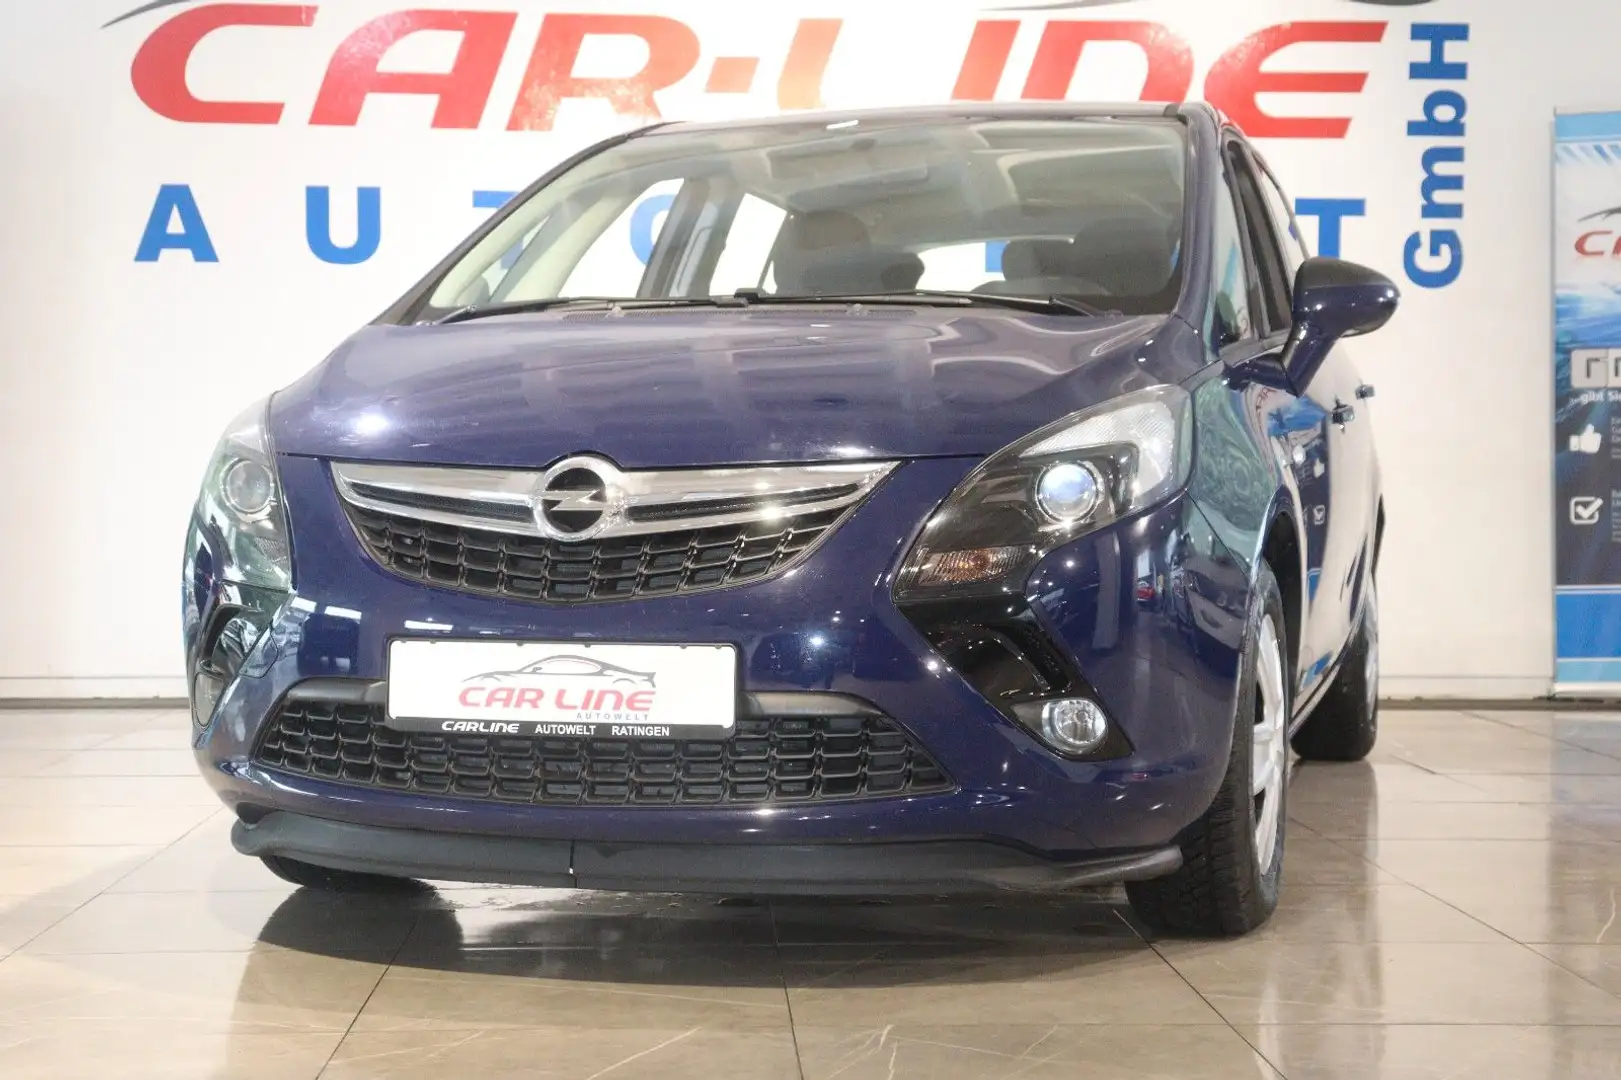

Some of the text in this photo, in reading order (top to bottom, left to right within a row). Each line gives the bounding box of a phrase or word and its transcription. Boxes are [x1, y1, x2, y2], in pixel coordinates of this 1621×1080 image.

[1403, 22, 1469, 290] GmbH
[458, 686, 657, 711] CAR LINE
[576, 712, 649, 721] AUTOWELT
[441, 720, 671, 737] CARLINE AUTOWELT RATINGEN
